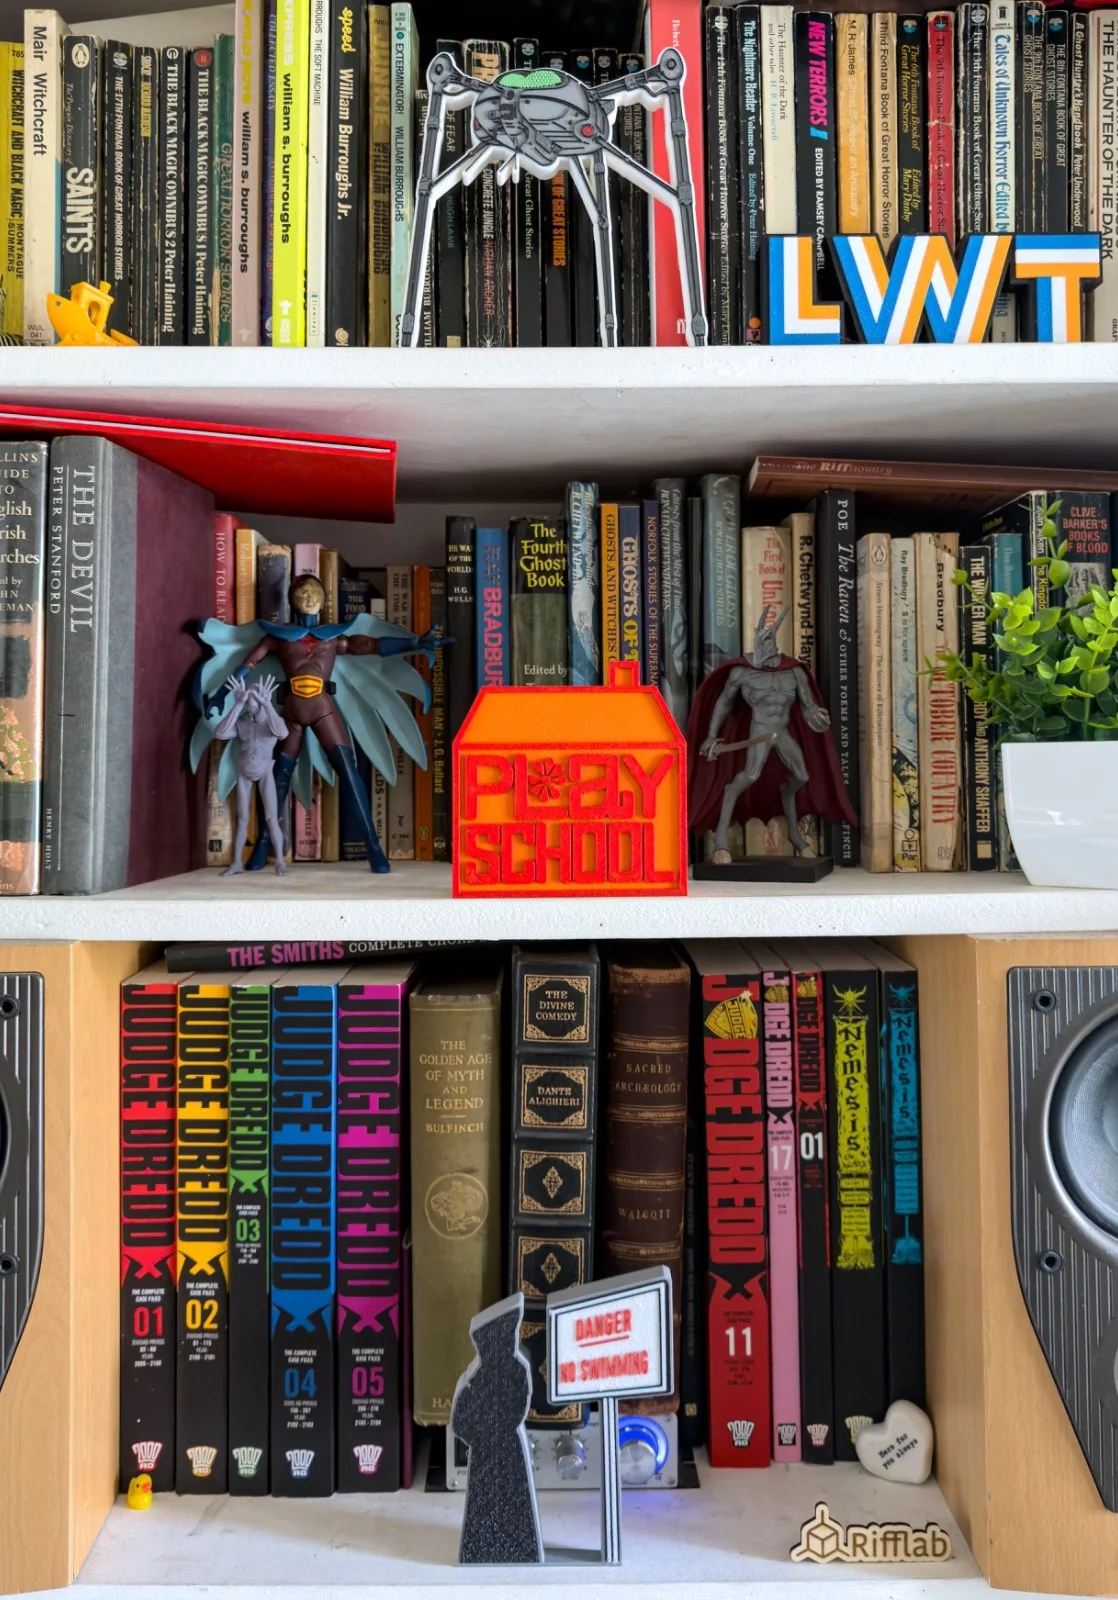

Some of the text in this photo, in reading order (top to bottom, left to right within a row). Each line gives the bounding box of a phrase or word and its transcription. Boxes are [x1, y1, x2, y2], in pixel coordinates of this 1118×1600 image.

[1074, 32, 1084, 58] Ghost
[33, 26, 47, 155] Mair Witchcraft
[1074, 60, 1083, 98] Hunter's
[335, 7, 356, 221] speed William Burroughs Jr.
[808, 21, 828, 226] NEW TERRORS EDITED BY RAMSEY
[880, 20, 892, 239] Third Fontana Book of Great Horror Stories
[994, 34, 1011, 226] Tales of Unknown Horror Edited
[1073, 99, 1083, 149] Handbook
[11, 70, 24, 218] WITCHCRAFT AND BLACK MAGIC
[394, 43, 405, 222] EXTERMINATOR! WILLIAM BURROUGHS
[1101, 21, 1114, 260] THE HAUNTER OF THE DARK
[279, 73, 292, 244] william burroughs
[1073, 155, 1083, 175] Peter
[162, 64, 178, 332] THE BLACK MAGIC OMNIBUS 2 Peter Haining
[193, 69, 209, 335] THE BLACK MAGIC OMNIBUS Peter Haining
[238, 111, 252, 273] william burroughs
[1073, 177, 1083, 227] Underwood
[65, 167, 94, 254] SAINTS
[7, 223, 16, 272] SUMMERS
[16, 223, 24, 280] MONTAGUE
[770, 236, 1099, 344] LWT
[1063, 519, 1107, 530] BARKER'S
[1071, 507, 1097, 518] CLIVE
[49, 466, 64, 615] PETER STANFORD
[521, 539, 568, 555] Fourth
[530, 523, 558, 538] The
[1069, 531, 1100, 541] BOOKS
[69, 466, 96, 634] THE DEVIL
[519, 556, 568, 573] Ghost
[1077, 543, 1109, 553] BLOOD
[526, 573, 566, 588] Book
[605, 514, 617, 653] GHOSTS AND WITCHES
[621, 536, 640, 648] GHOSTS OF
[647, 516, 658, 641] NORFOLK STORIES OF THE
[837, 500, 855, 748] POE The Raven OTHER POEMS AND
[524, 664, 556, 675] Edited
[931, 562, 957, 825] Bradbury COUNTRY
[971, 556, 991, 833] THE MAN ANTHONY SHAFFER
[466, 823, 677, 884] SCHOOL
[227, 940, 424, 968] THE SMITHS COMPLETE
[539, 1001, 575, 1010] DIVINE
[546, 991, 568, 999] THE
[536, 1012, 577, 1021] COMEDY
[440, 1040, 467, 1051] THE
[701, 974, 761, 1114] JDGE
[762, 971, 793, 1107] JDGE DREDD
[419, 1054, 492, 1065] GOLDEN AGE
[425, 1069, 485, 1082] OF MYTH
[626, 1063, 672, 1074] SACRED
[798, 1031, 821, 1093] DREDD
[230, 986, 269, 1172] JUDGE DREDD
[442, 1085, 468, 1096] AND
[537, 1086, 572, 1096] DANTE
[614, 1082, 682, 1094] ARCHÆOLOGY
[843, 1024, 863, 1153] Nemesis
[121, 984, 176, 1248] JUDGE DREDD
[178, 985, 228, 1243] JUDGE DREDD
[425, 1098, 484, 1110] LEGEND
[529, 1096, 580, 1107] ALIGHIERI
[272, 986, 333, 1291] JUDGE DREDD
[337, 985, 400, 1298] JUDGE DREDD
[426, 1122, 485, 1134] BULFINCH
[769, 1145, 793, 1171] 17
[800, 1132, 825, 1160] 01
[705, 1120, 766, 1264] DREDD
[235, 1219, 261, 1242] 03
[618, 1208, 672, 1220] WALCOTT
[133, 1306, 164, 1338] 01
[186, 1298, 219, 1330] 02
[575, 1309, 632, 1342] DANGER
[725, 1326, 752, 1357] 11
[284, 1368, 317, 1398] 04
[352, 1366, 384, 1397] 05
[559, 1351, 649, 1384] NO SWIMMING
[878, 1433, 908, 1458] Here for
[882, 1438, 918, 1470] you always
[852, 1530, 947, 1558] Rifflab
